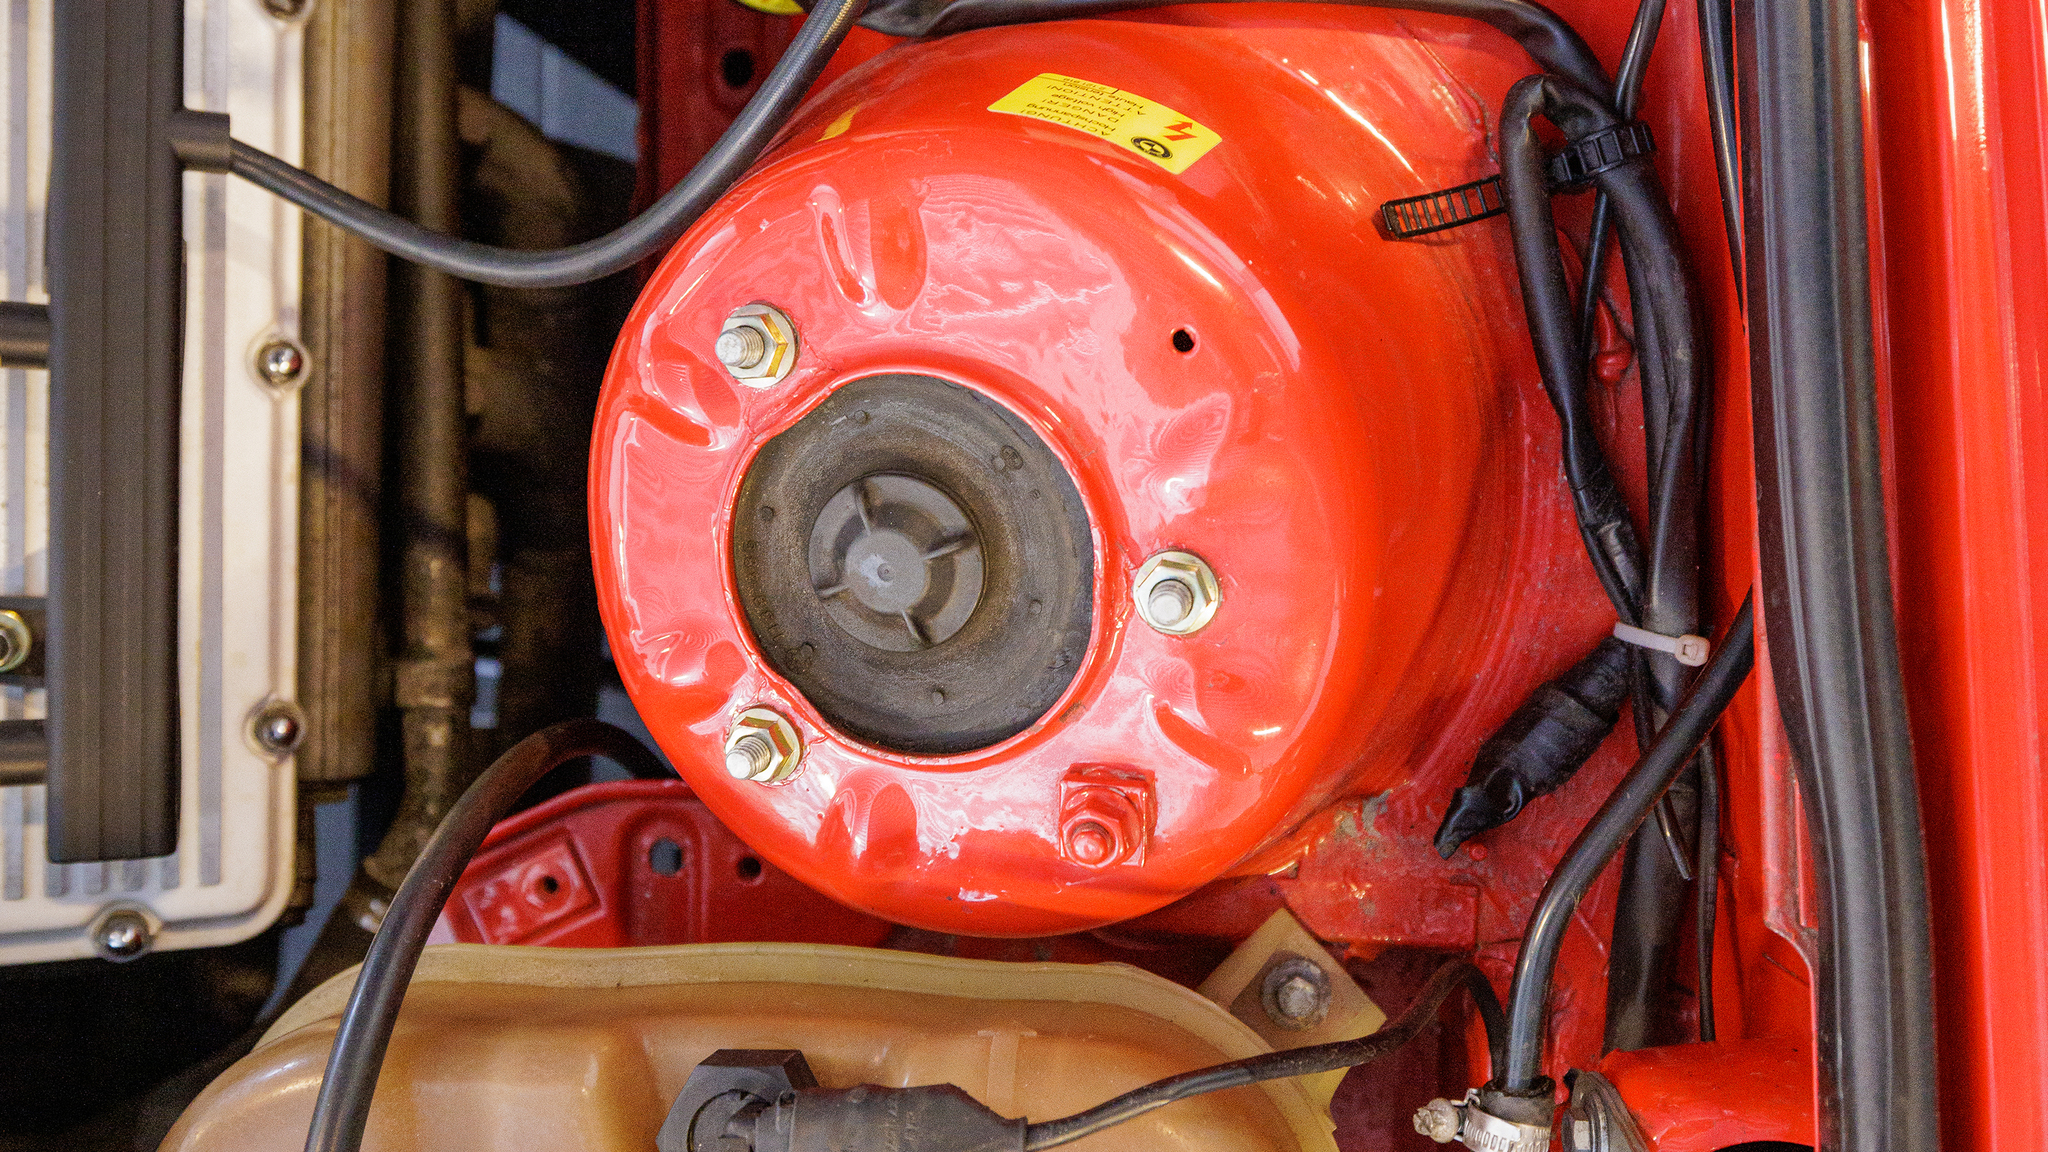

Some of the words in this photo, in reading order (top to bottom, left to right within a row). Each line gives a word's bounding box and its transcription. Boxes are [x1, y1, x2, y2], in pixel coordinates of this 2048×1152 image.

[1063, 81, 1104, 96] tension
[1046, 84, 1147, 116] ATTENTION!
[1051, 93, 1095, 107] voltage
[1108, 94, 1145, 109] Haute
[1026, 103, 1117, 132] Hochspannung
[1042, 98, 1120, 124] DANGER!
[1098, 106, 1125, 118] High
[1020, 109, 1111, 136] ACHTUNG!
